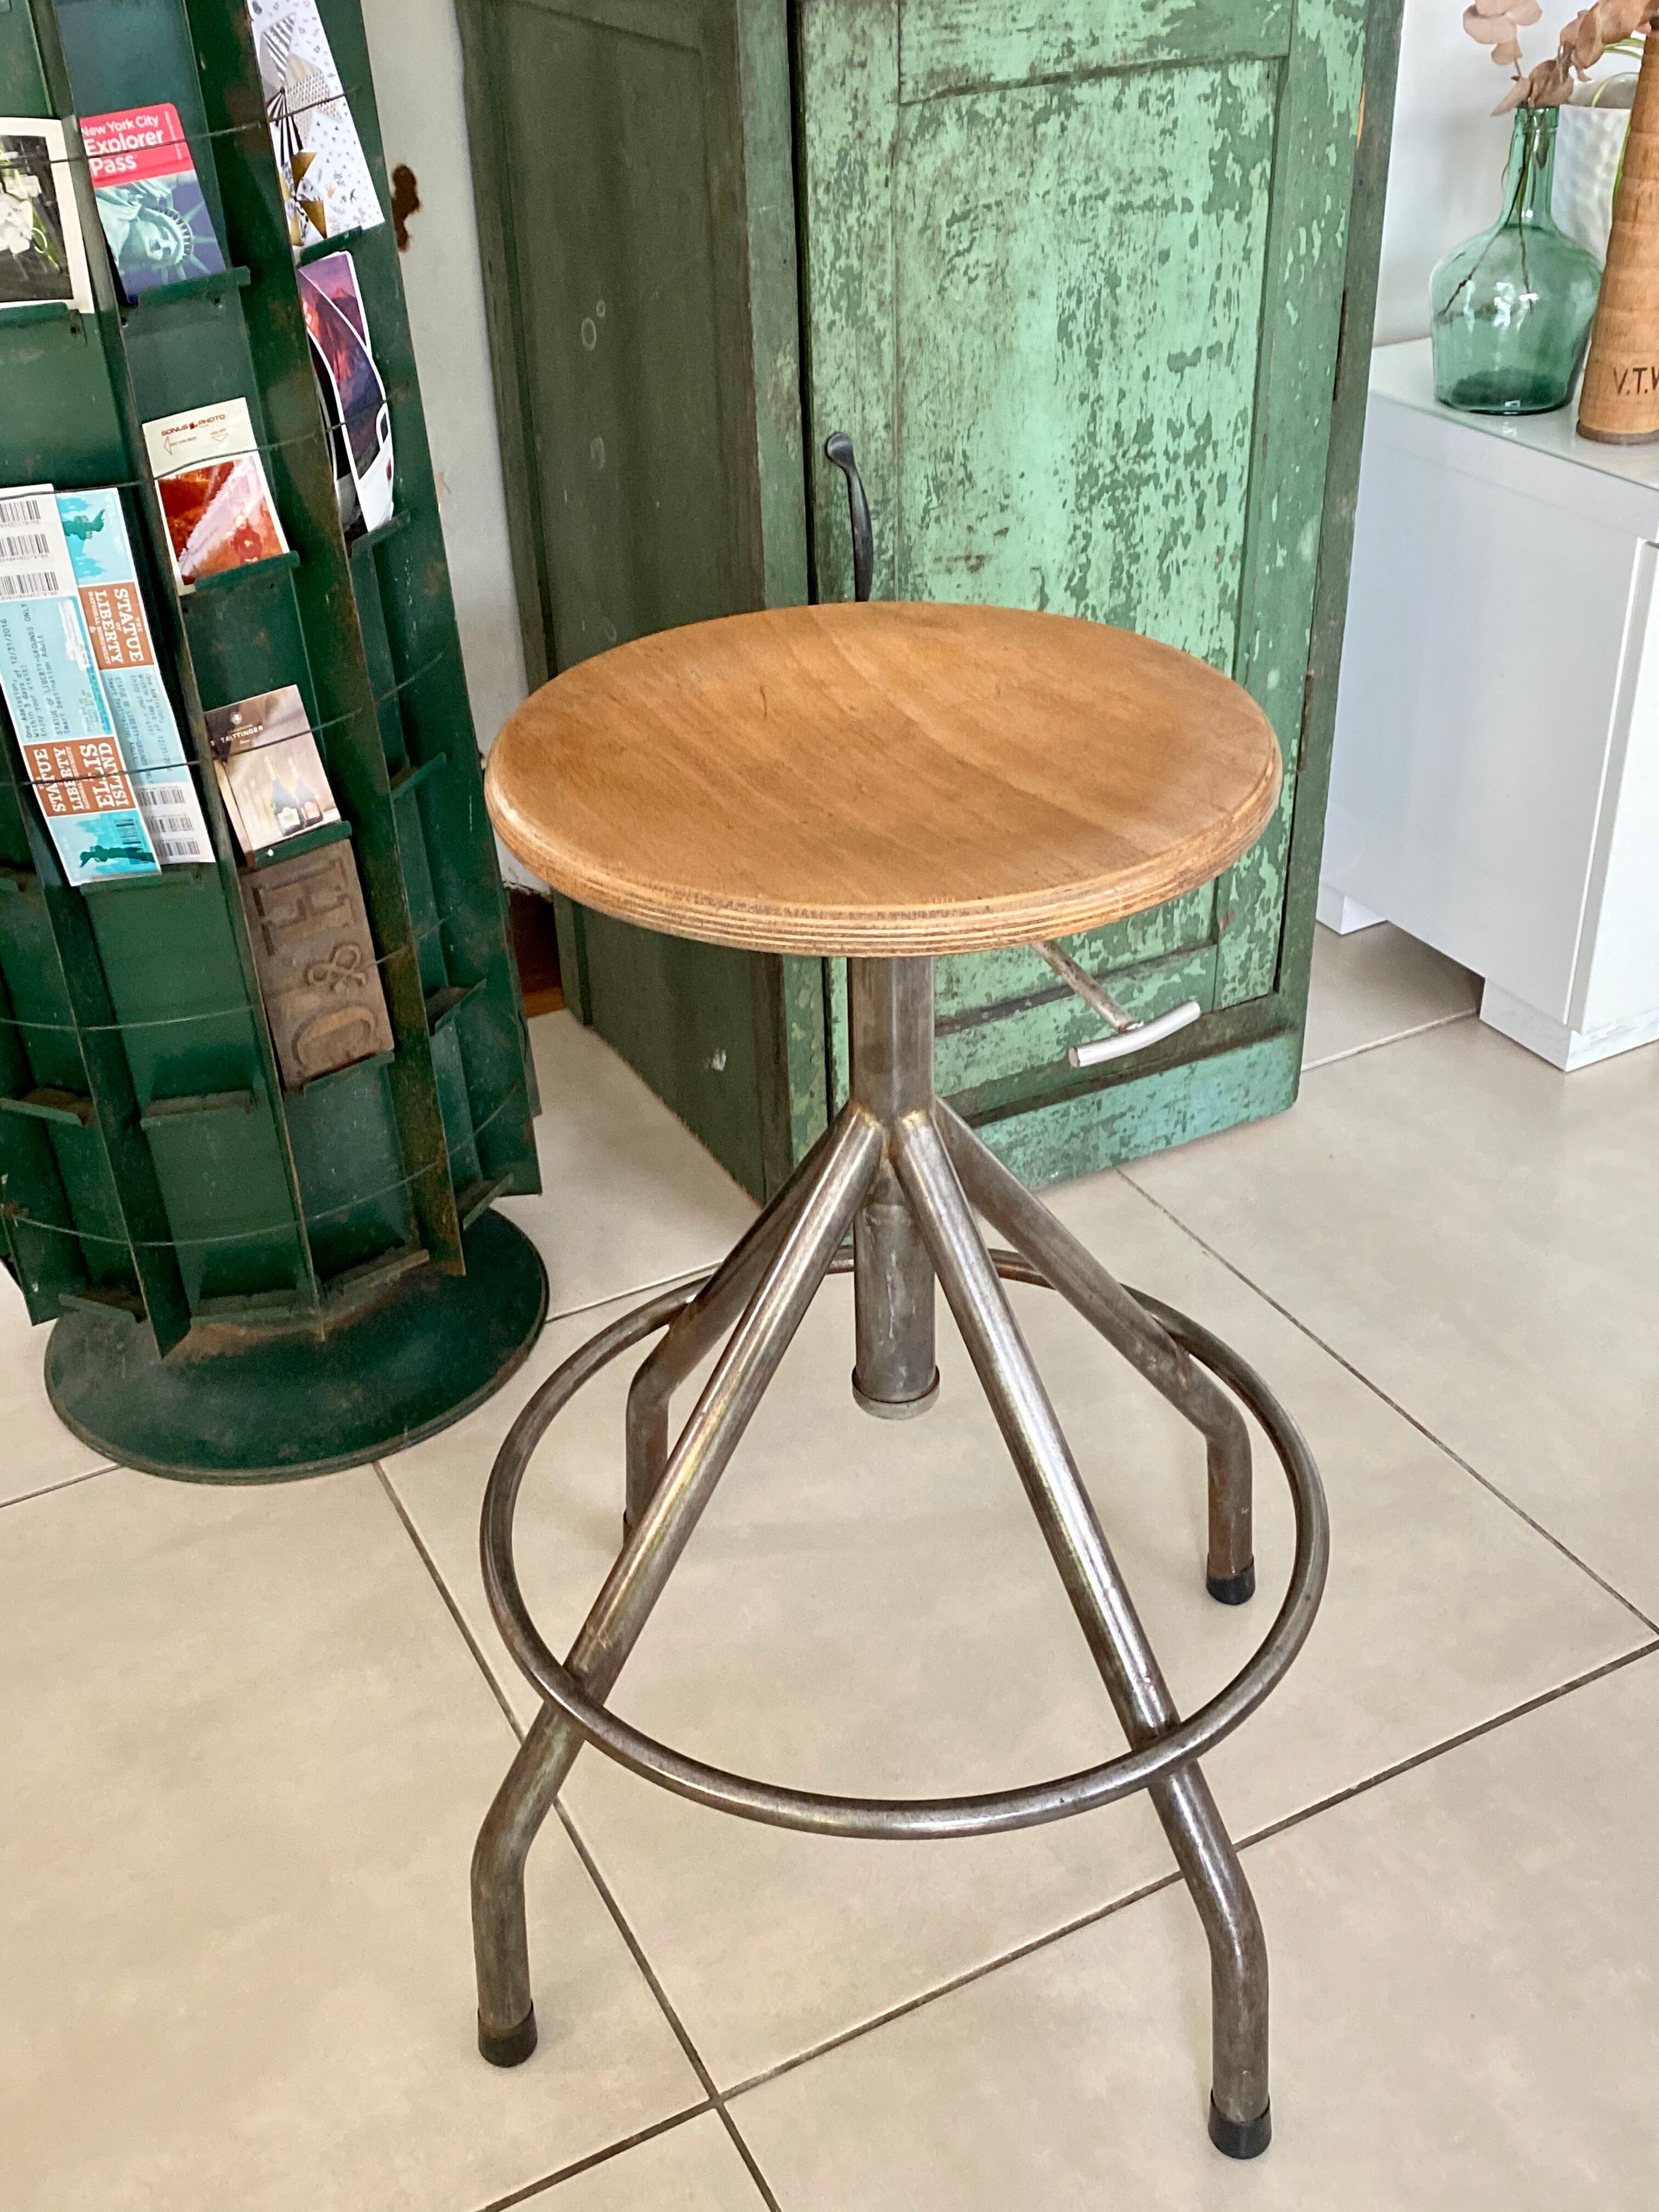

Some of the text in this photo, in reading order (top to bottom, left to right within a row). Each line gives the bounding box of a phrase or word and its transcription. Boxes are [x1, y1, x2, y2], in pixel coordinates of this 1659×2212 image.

[81, 115, 159, 137] New York City
[83, 129, 163, 156] Explorer
[88, 154, 137, 176] Pass
[161, 414, 225, 436] BONUS PHOTO
[21, 603, 31, 622] ONLY
[114, 588, 144, 662] STATUE
[88, 591, 100, 625] NATIONAL
[97, 627, 110, 664] MONUMENT
[94, 590, 123, 663] LIBERTY
[1, 618, 18, 664] 12/31/2016
[27, 627, 50, 693] LIBERTY-GROUNDS
[13, 669, 22, 678] of
[20, 682, 29, 699] days
[30, 694, 42, 711] your
[10, 679, 32, 738] One Admission,
[27, 712, 39, 737] Within
[37, 715, 47, 737] Enjoy
[50, 710, 63, 735] STATUE
[59, 713, 70, 734] Smart
[220, 725, 263, 743] TAITTINGER
[158, 736, 173, 771] 12/31/206
[33, 749, 67, 812] STATUE
[98, 743, 129, 805] ISLAND
